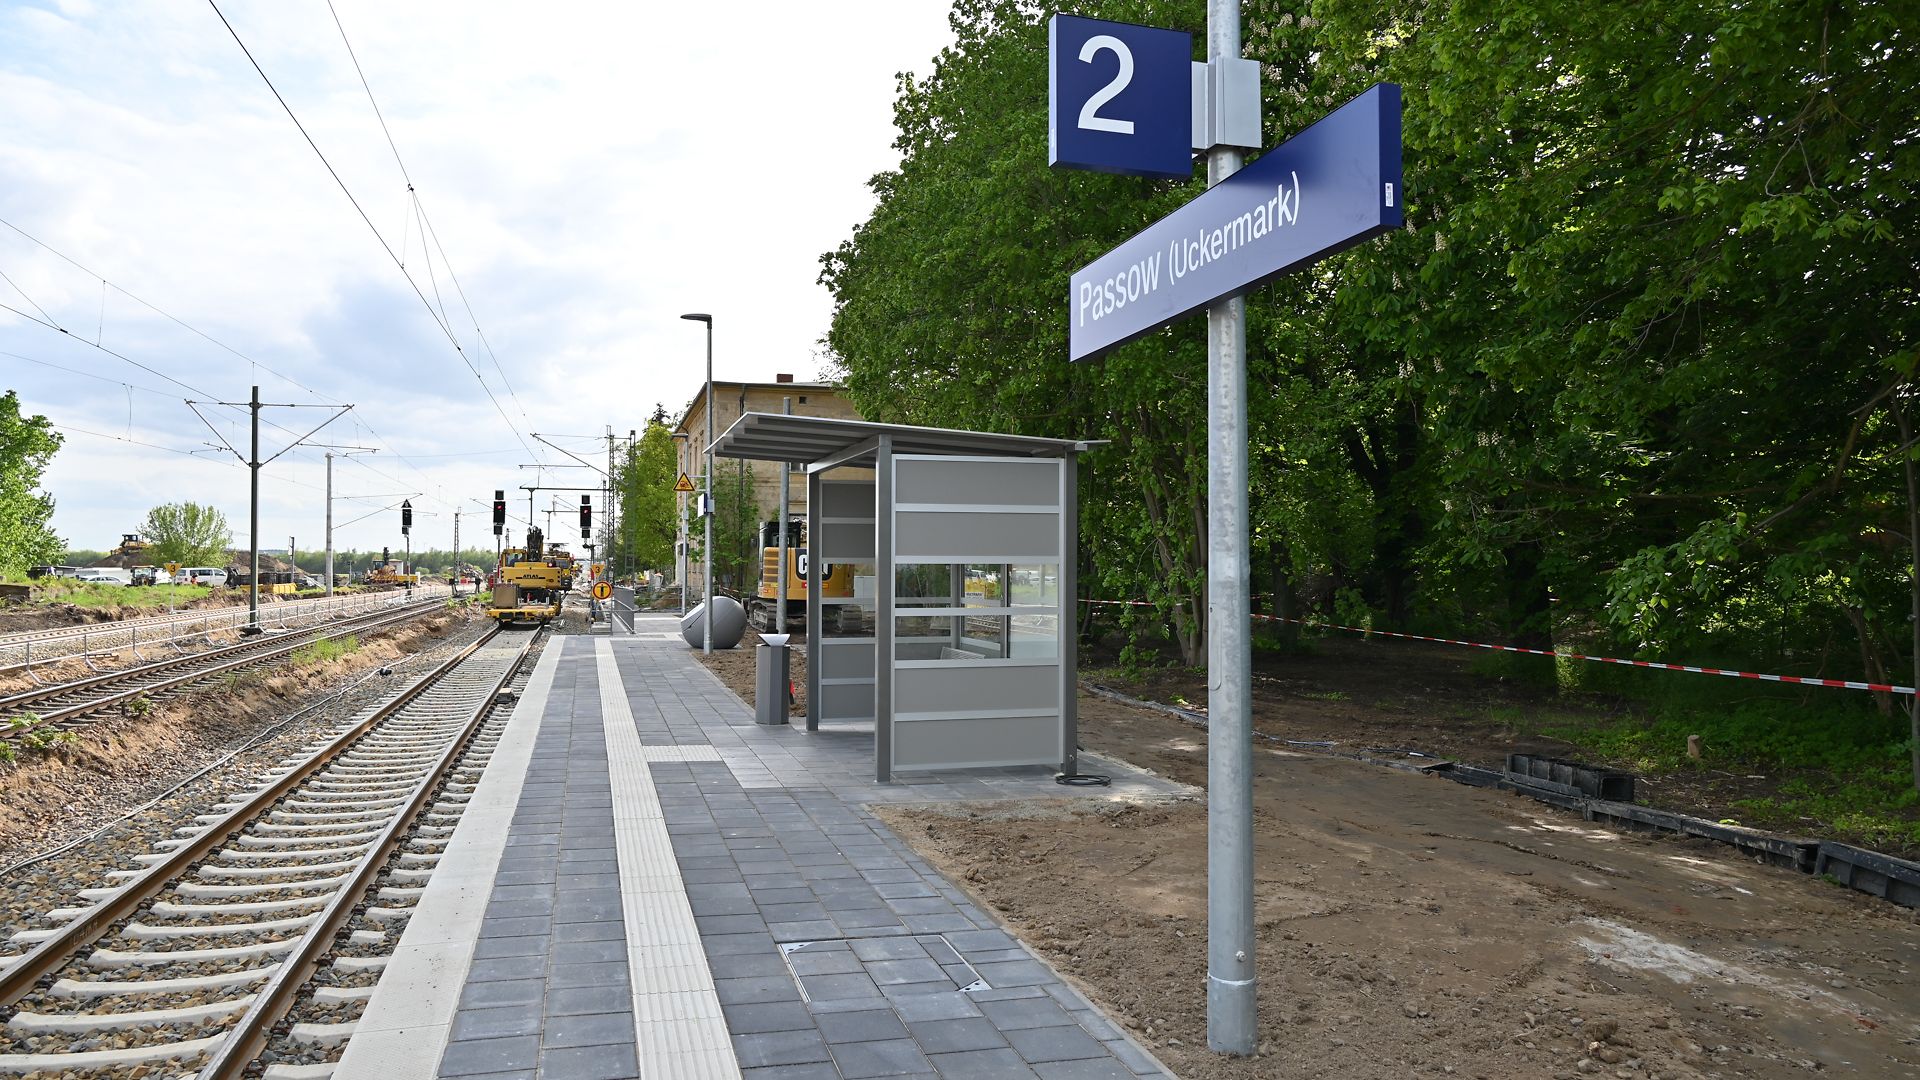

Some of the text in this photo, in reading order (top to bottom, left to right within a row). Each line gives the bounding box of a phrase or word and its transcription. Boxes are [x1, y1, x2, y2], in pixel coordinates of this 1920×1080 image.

[1077, 35, 1134, 134] 2
[1080, 170, 1300, 327] Passow (Uckermark)
